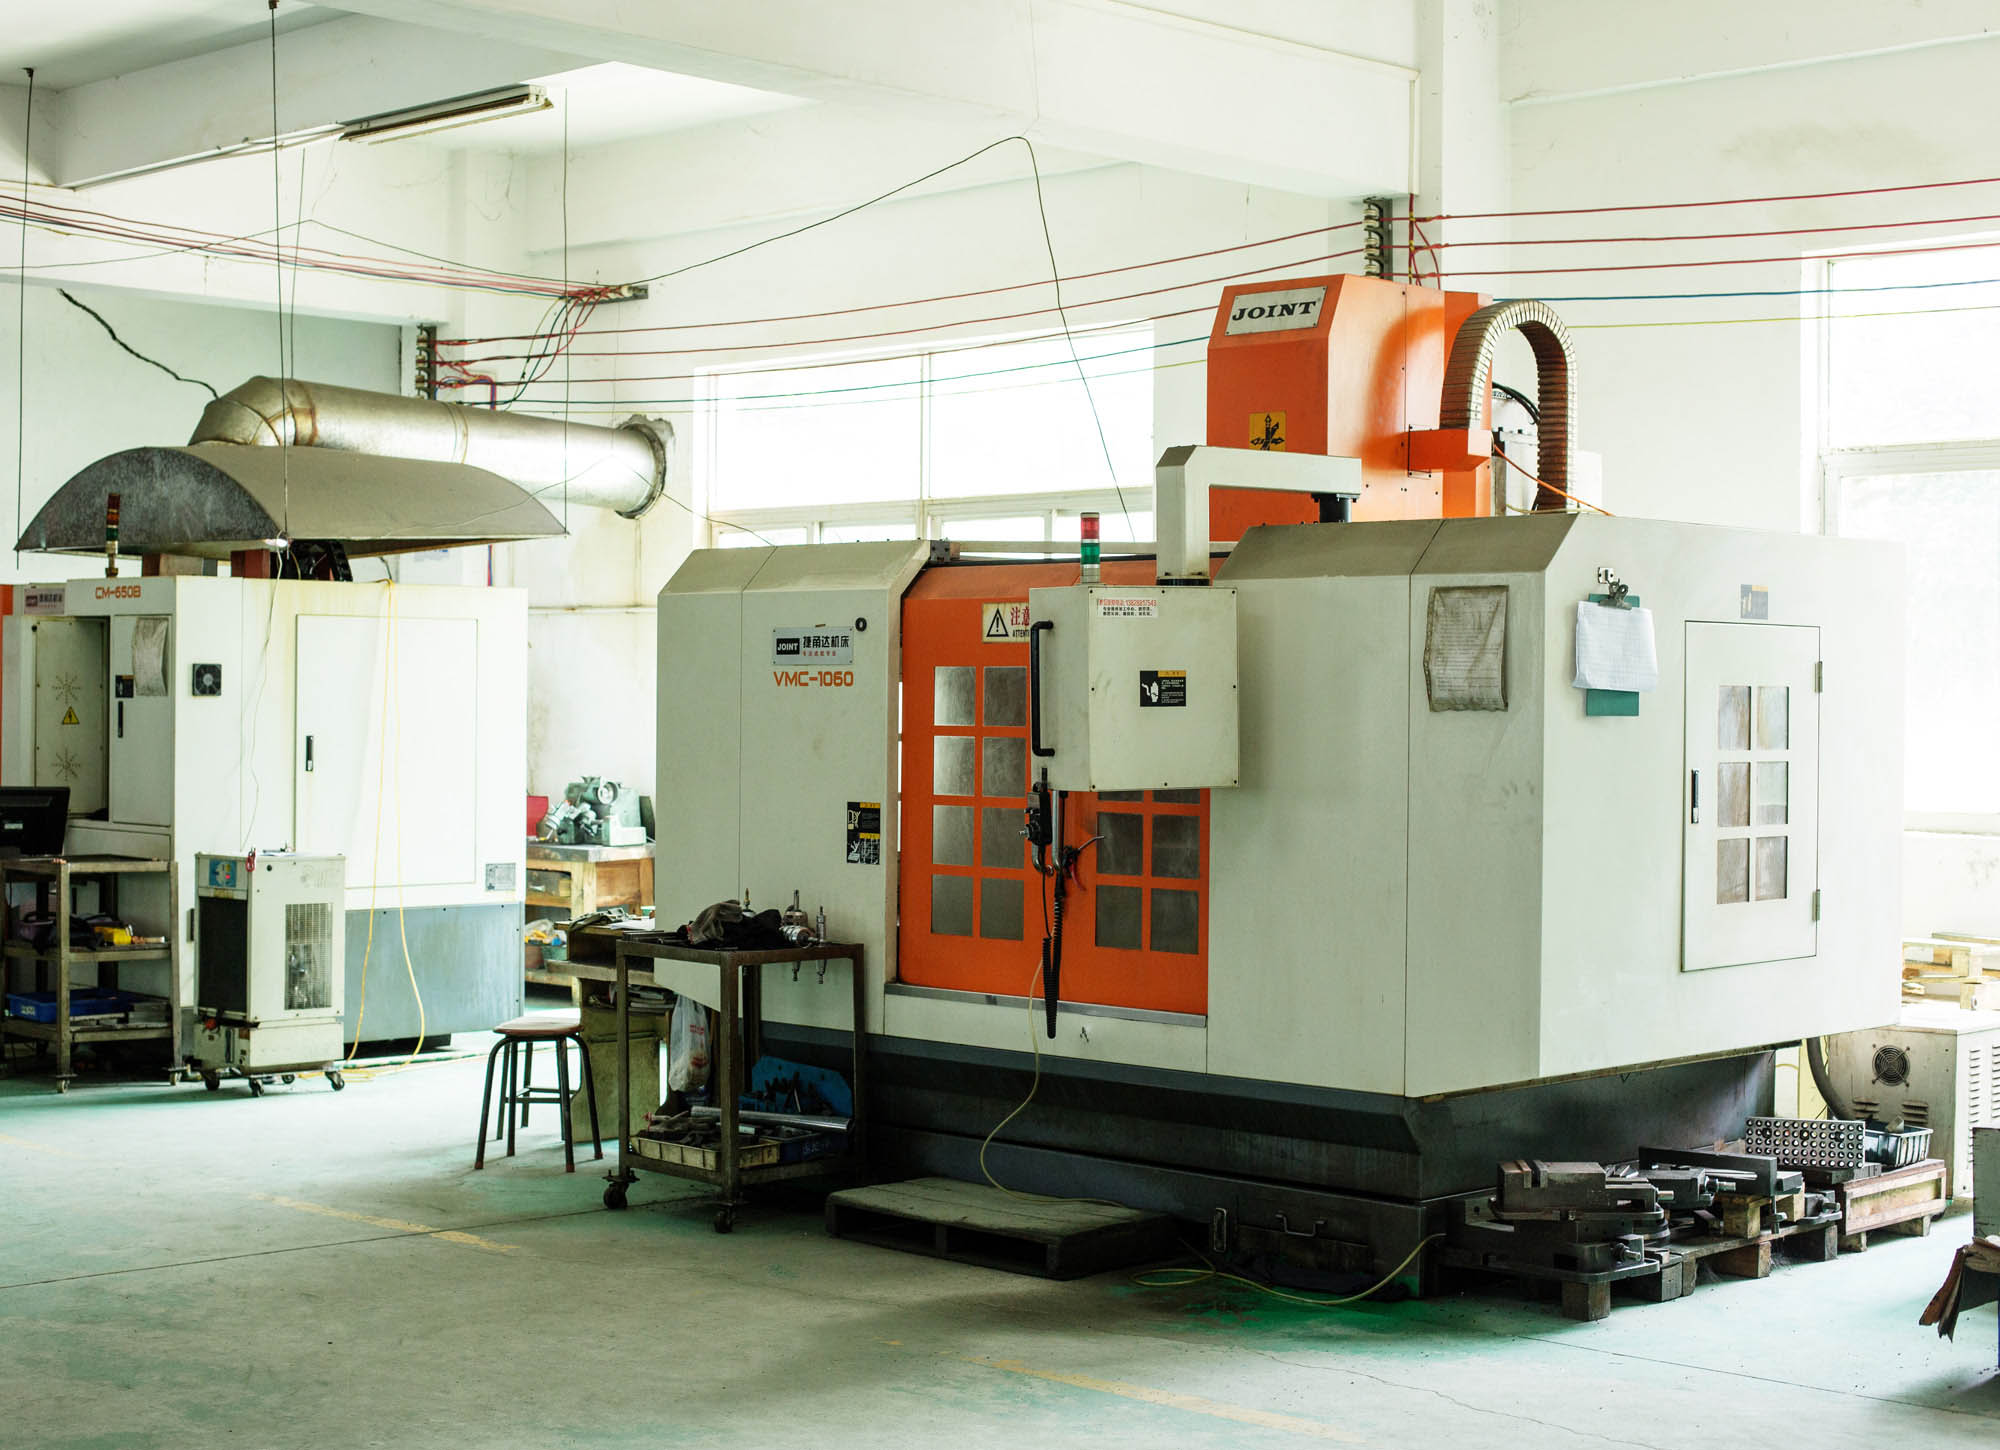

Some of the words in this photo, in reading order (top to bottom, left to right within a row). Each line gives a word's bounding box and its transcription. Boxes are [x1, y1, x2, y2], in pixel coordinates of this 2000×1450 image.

[1232, 301, 1316, 321] JOINT
[95, 585, 142, 600] CM-650B
[777, 642, 799, 651] JOINT
[773, 671, 854, 688] VMC-1060
